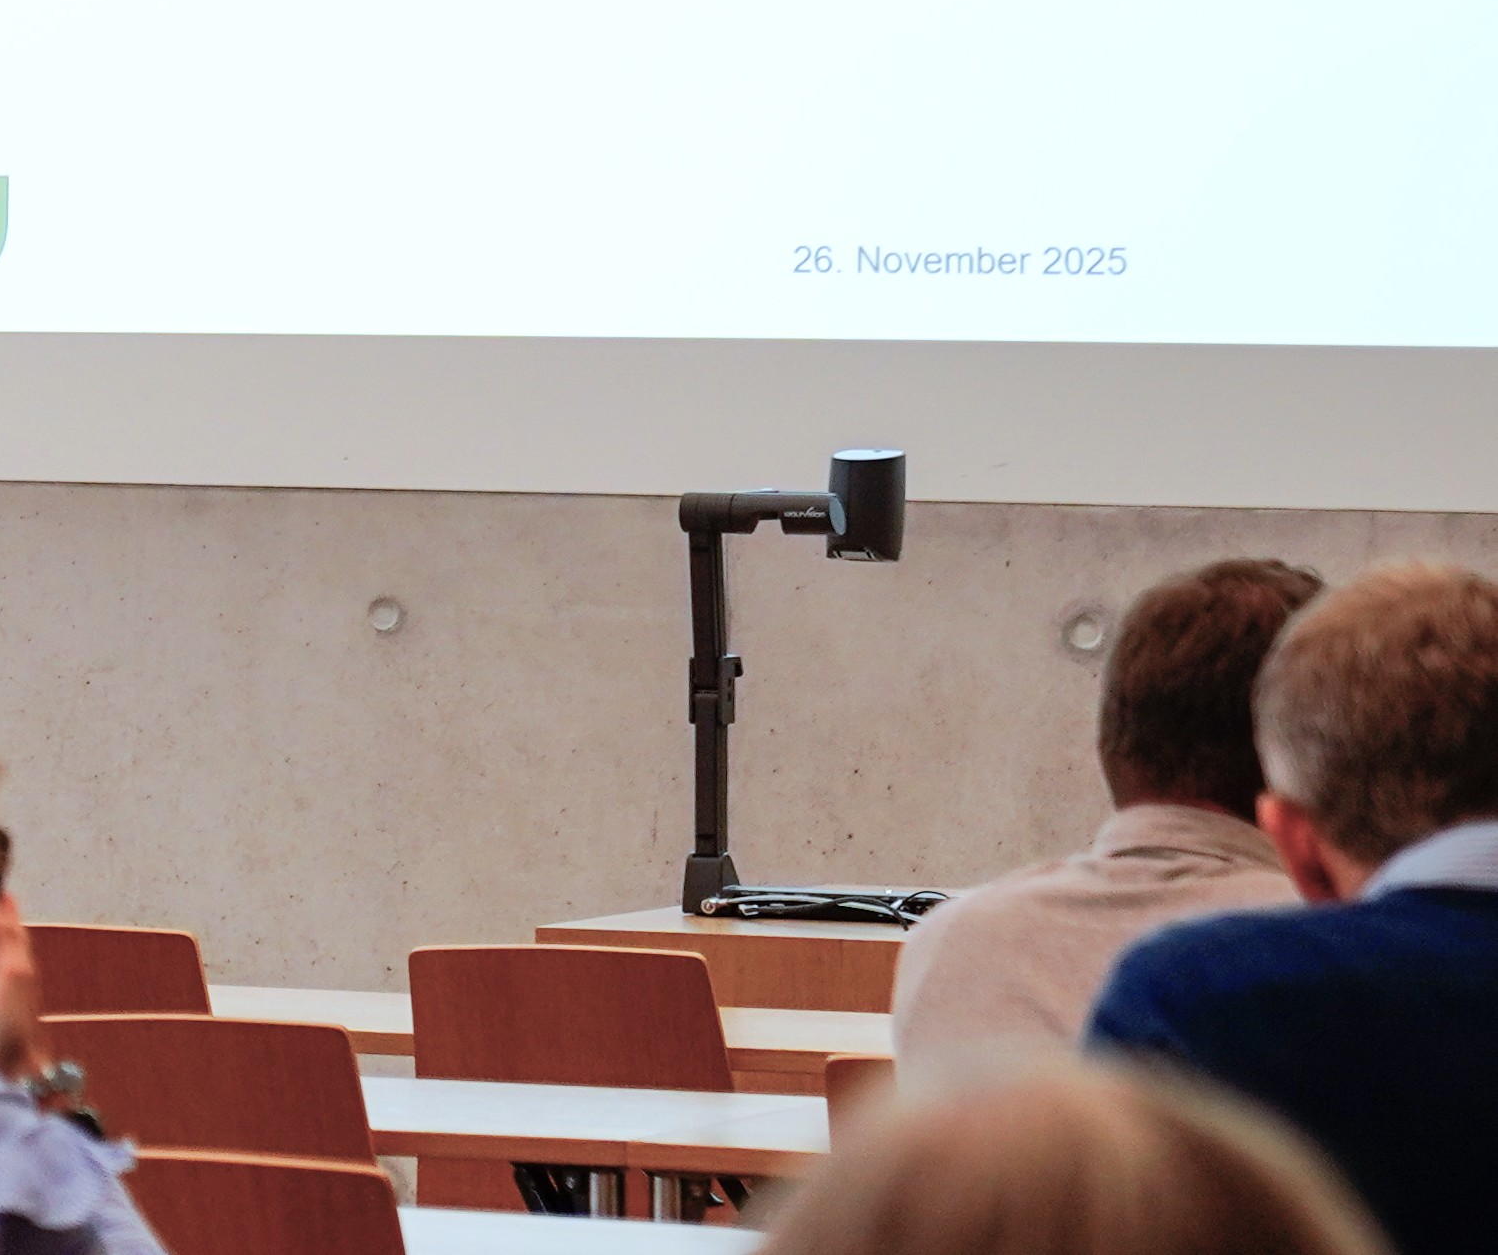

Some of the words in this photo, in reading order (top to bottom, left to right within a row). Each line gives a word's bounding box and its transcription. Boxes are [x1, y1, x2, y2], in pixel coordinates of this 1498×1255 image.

[793, 245, 841, 274] 26.
[857, 245, 1032, 275] November
[1042, 246, 1128, 276] 2025
